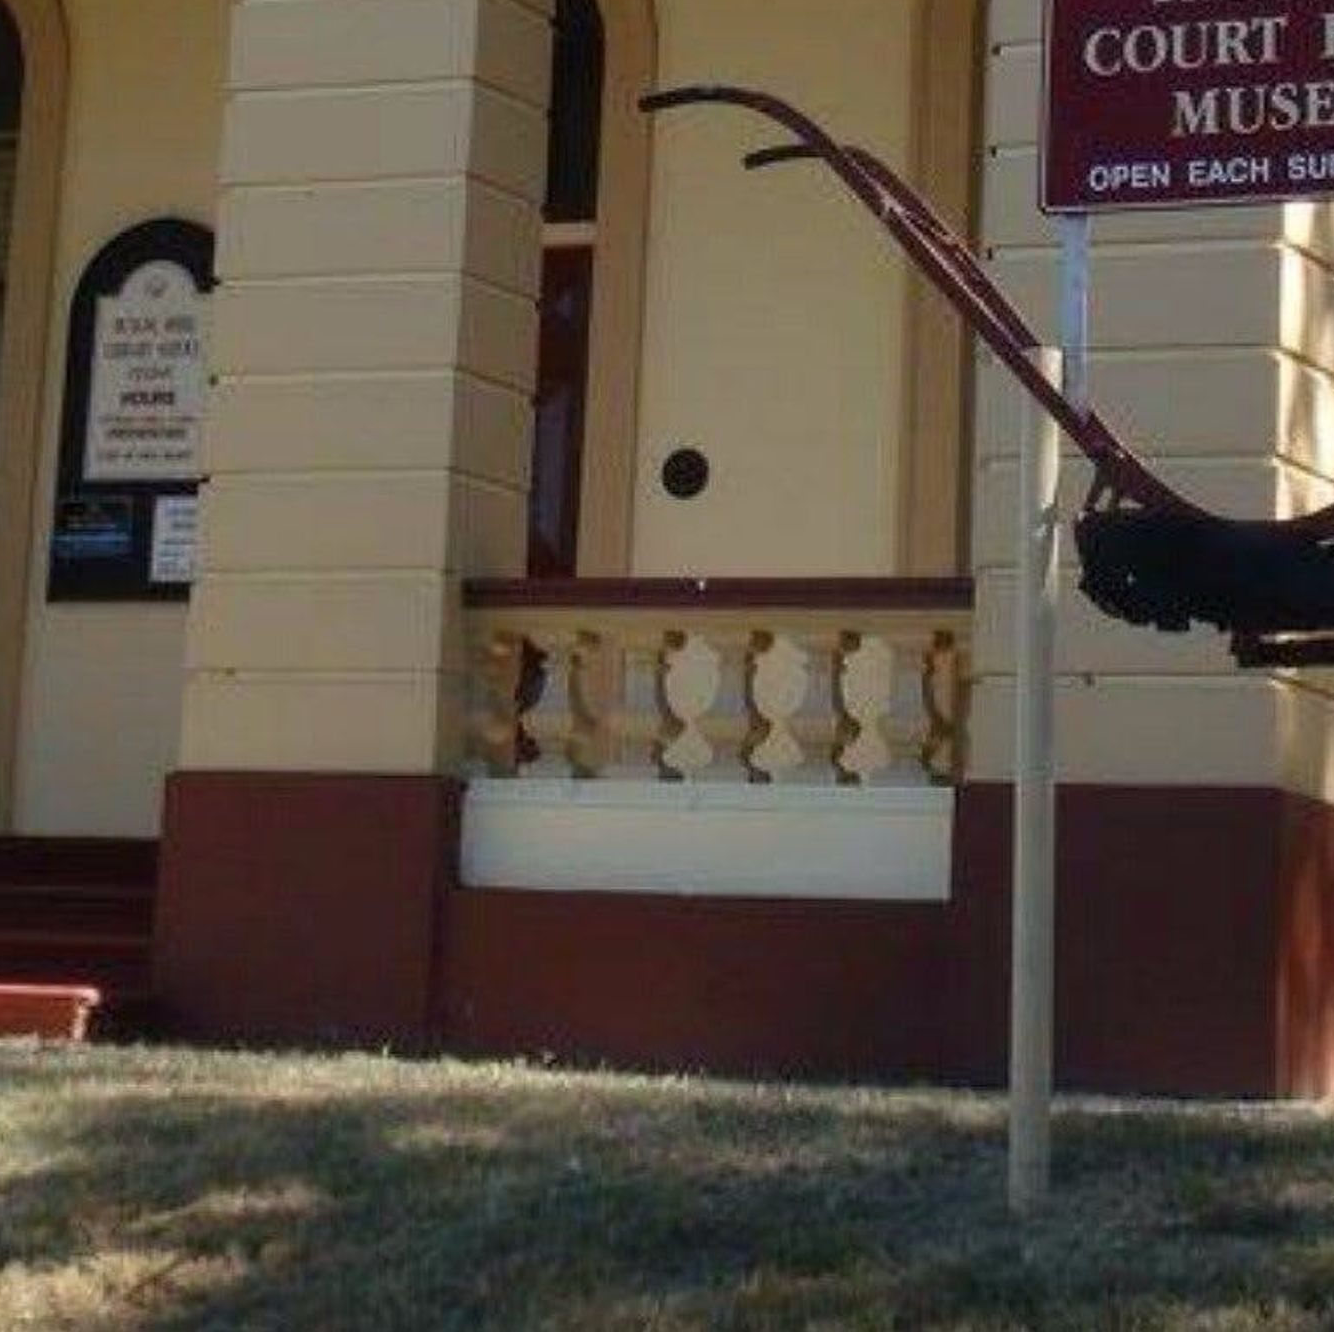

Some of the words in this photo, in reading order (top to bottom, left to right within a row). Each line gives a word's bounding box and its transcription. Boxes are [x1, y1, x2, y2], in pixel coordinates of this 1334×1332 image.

[1084, 16, 1288, 76] COURT
[1089, 158, 1170, 191] OPEN
[1187, 153, 1269, 186] EACH
